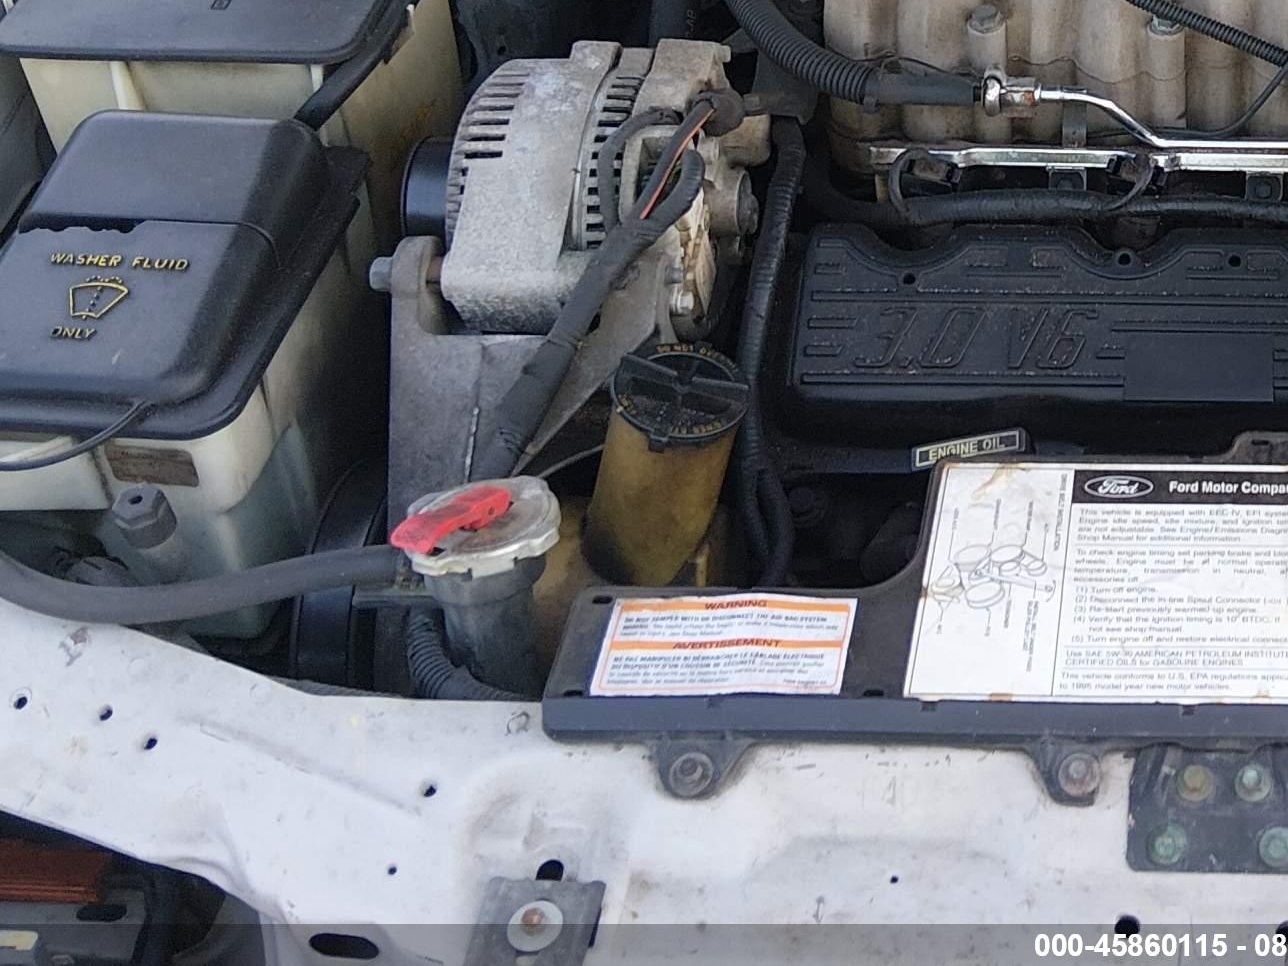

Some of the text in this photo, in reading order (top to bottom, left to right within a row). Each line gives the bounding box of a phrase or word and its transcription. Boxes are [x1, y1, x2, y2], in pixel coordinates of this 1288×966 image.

[50, 253, 189, 270] WASHER FLUID
[50, 326, 97, 339] ONLY
[853, 307, 1099, 369] 3.0 V6
[928, 436, 1006, 460] ENGINE OIL
[1097, 478, 1140, 495] Ford
[1169, 481, 1199, 493] Ford
[1201, 481, 1238, 494] Motor
[704, 599, 767, 610] WARNING
[672, 638, 782, 650] AVERTISSEMENT
[1134, 650, 1183, 658] AMERICAN
[1185, 650, 1242, 658] PETROLEUM
[1065, 658, 1114, 666] CERTIFIED
[1116, 658, 1137, 666] OILS
[1139, 658, 1151, 666] for
[1152, 658, 1199, 666] GASOLINE
